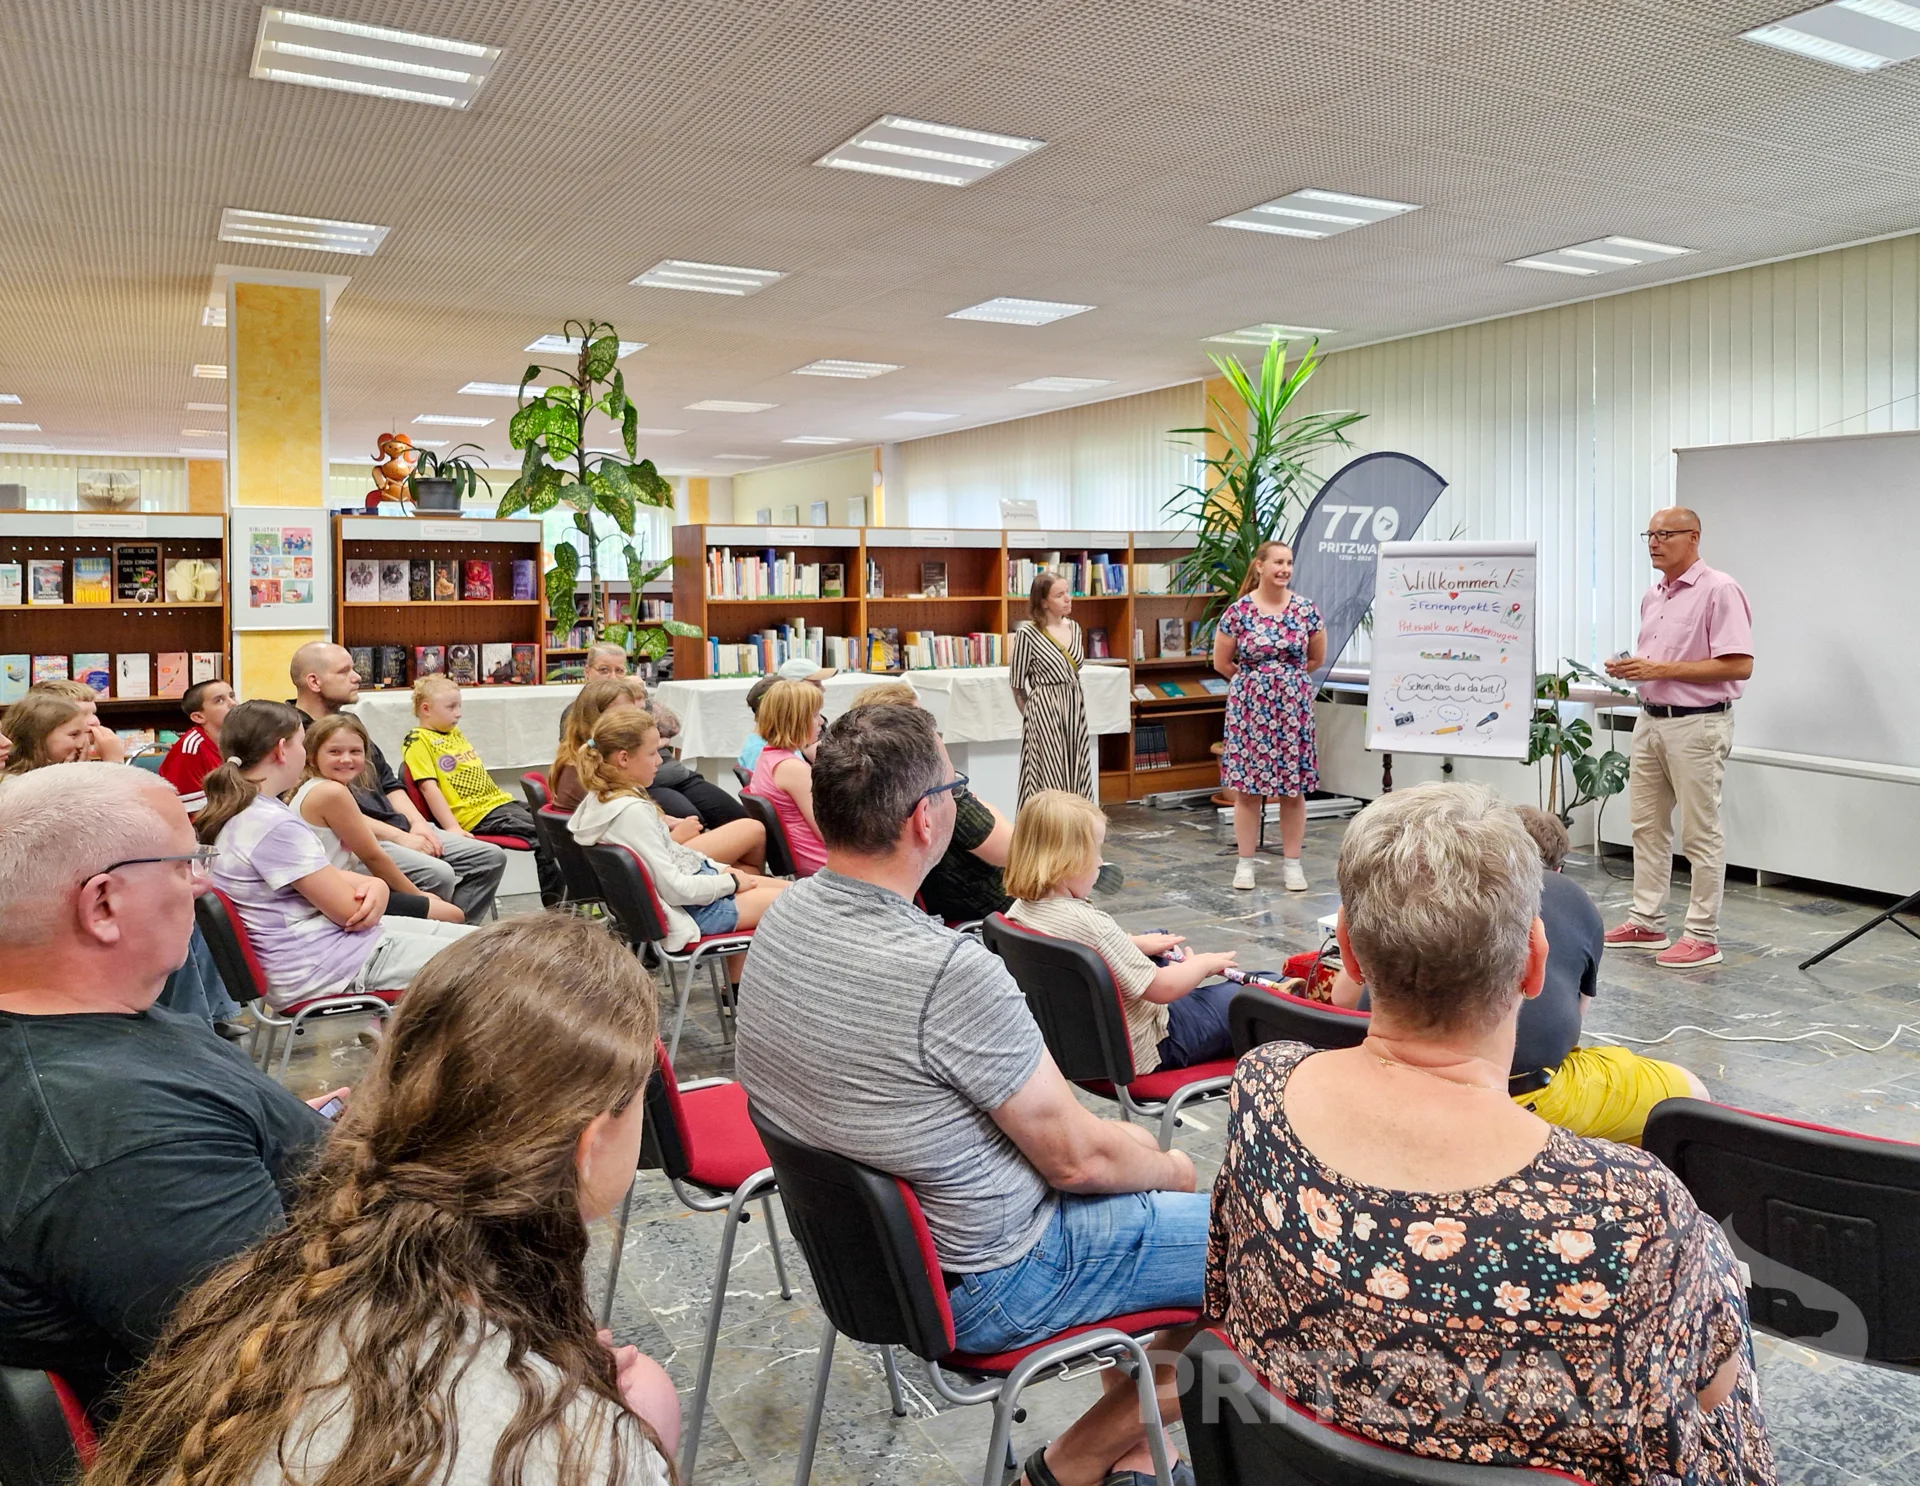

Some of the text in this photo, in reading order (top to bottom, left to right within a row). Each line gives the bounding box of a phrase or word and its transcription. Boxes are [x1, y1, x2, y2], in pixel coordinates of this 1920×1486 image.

[1322, 504, 1399, 541] 770
[1319, 541, 1378, 555] PRITZWA
[1419, 601, 1489, 615] Ferienprojekt
[1463, 620, 1519, 643] Kinderaugen
[1434, 682, 1451, 691] dass
[1454, 683, 1465, 691] du
[1467, 684, 1478, 692] da
